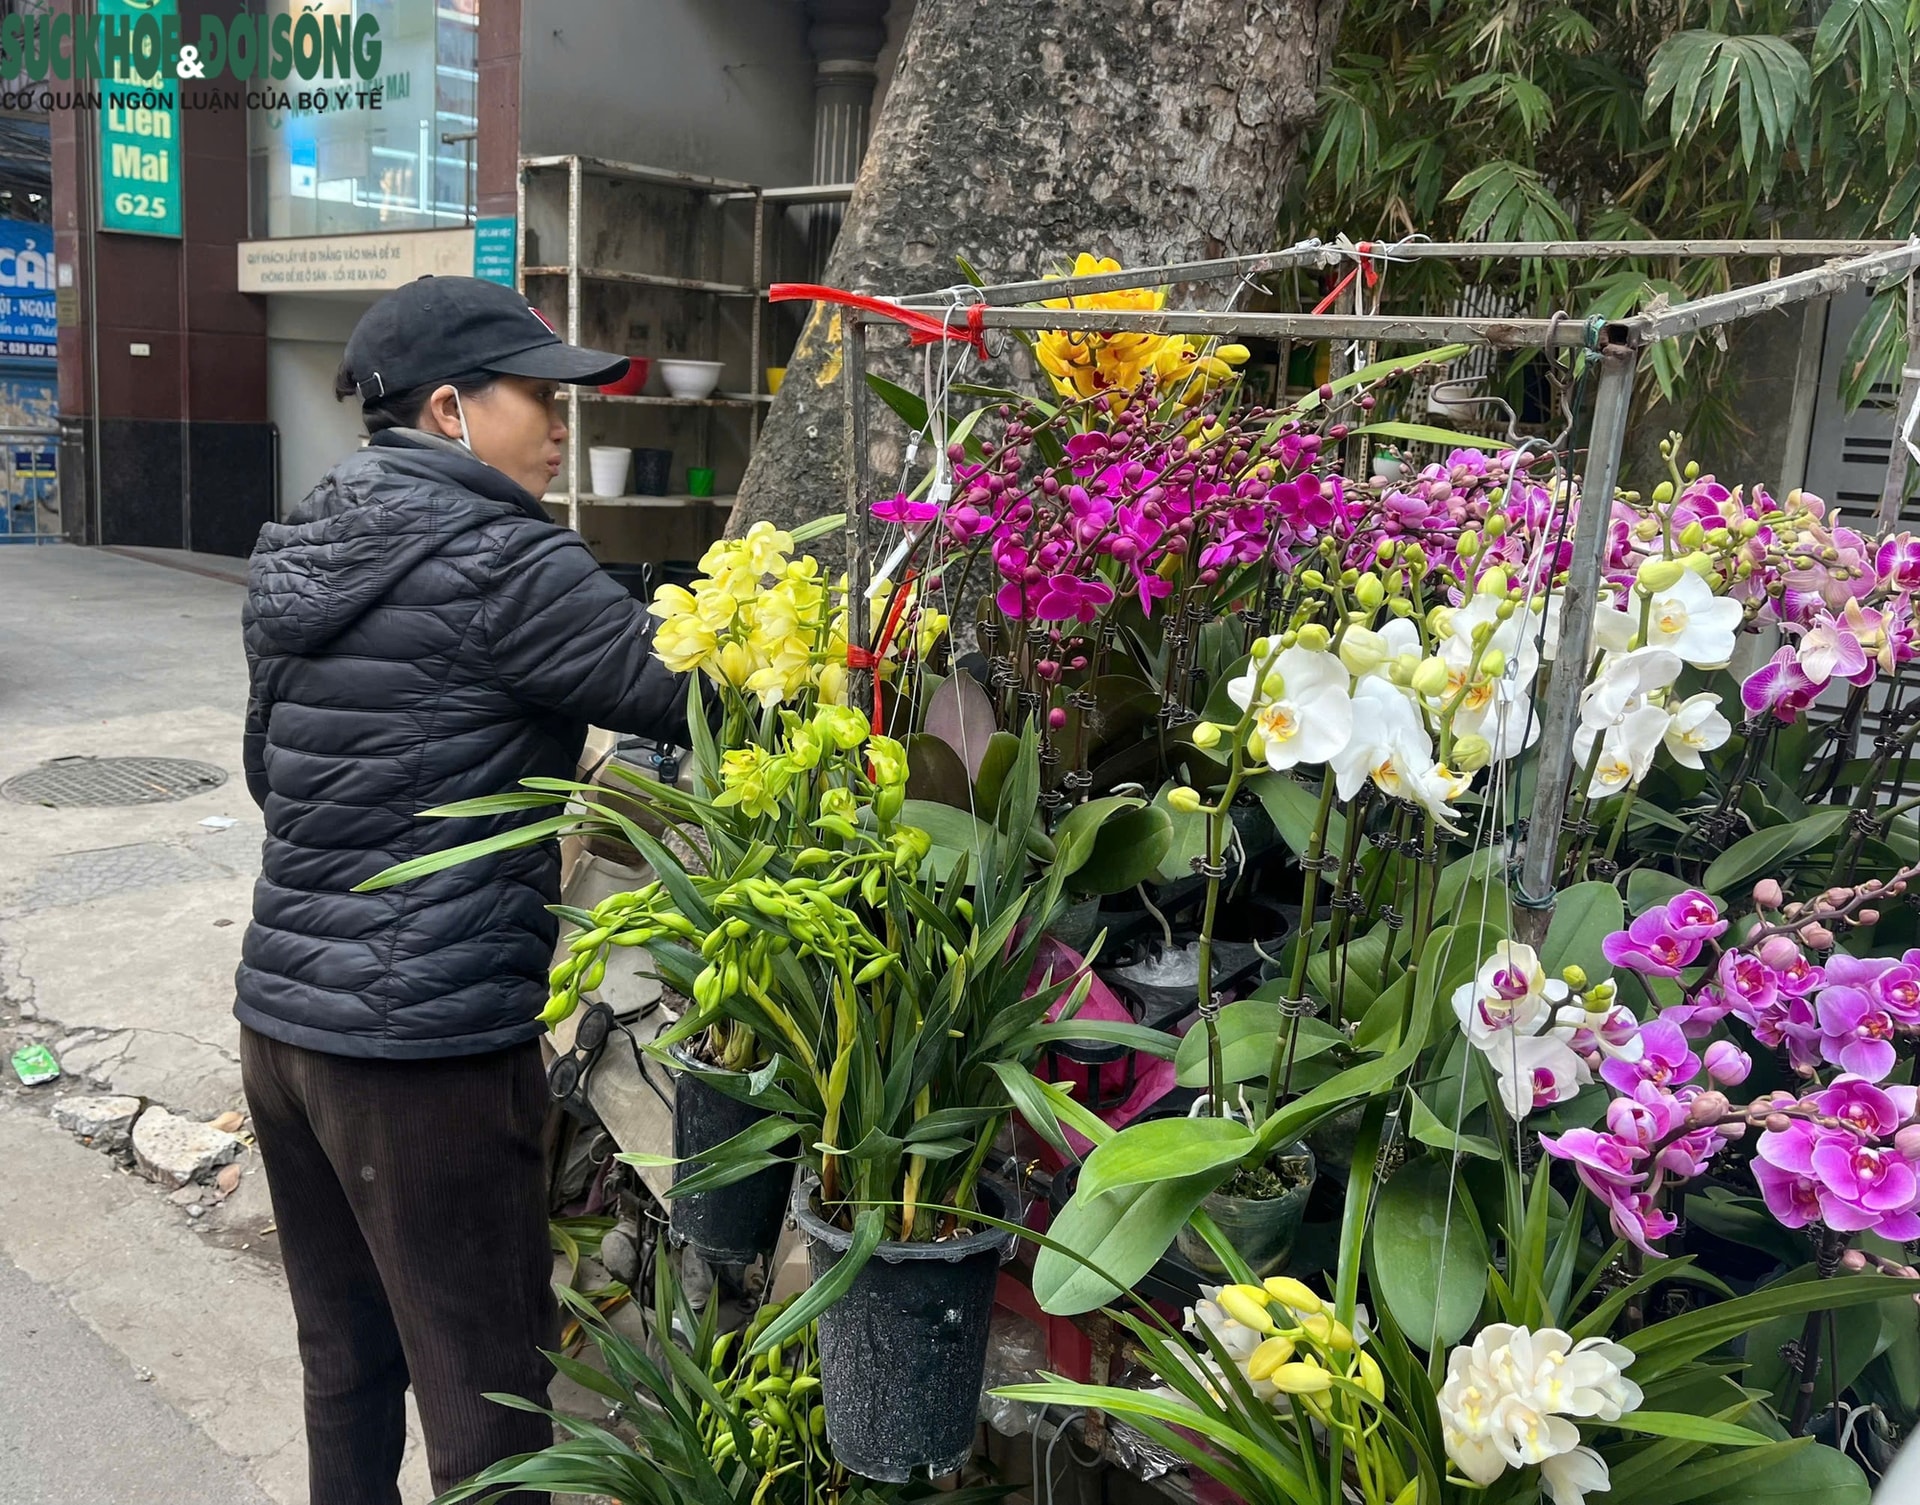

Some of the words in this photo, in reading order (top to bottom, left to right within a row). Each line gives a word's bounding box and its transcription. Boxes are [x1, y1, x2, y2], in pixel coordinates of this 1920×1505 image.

[386, 71, 410, 101] MAI
[111, 143, 169, 183] Mai
[115, 192, 167, 219] 625
